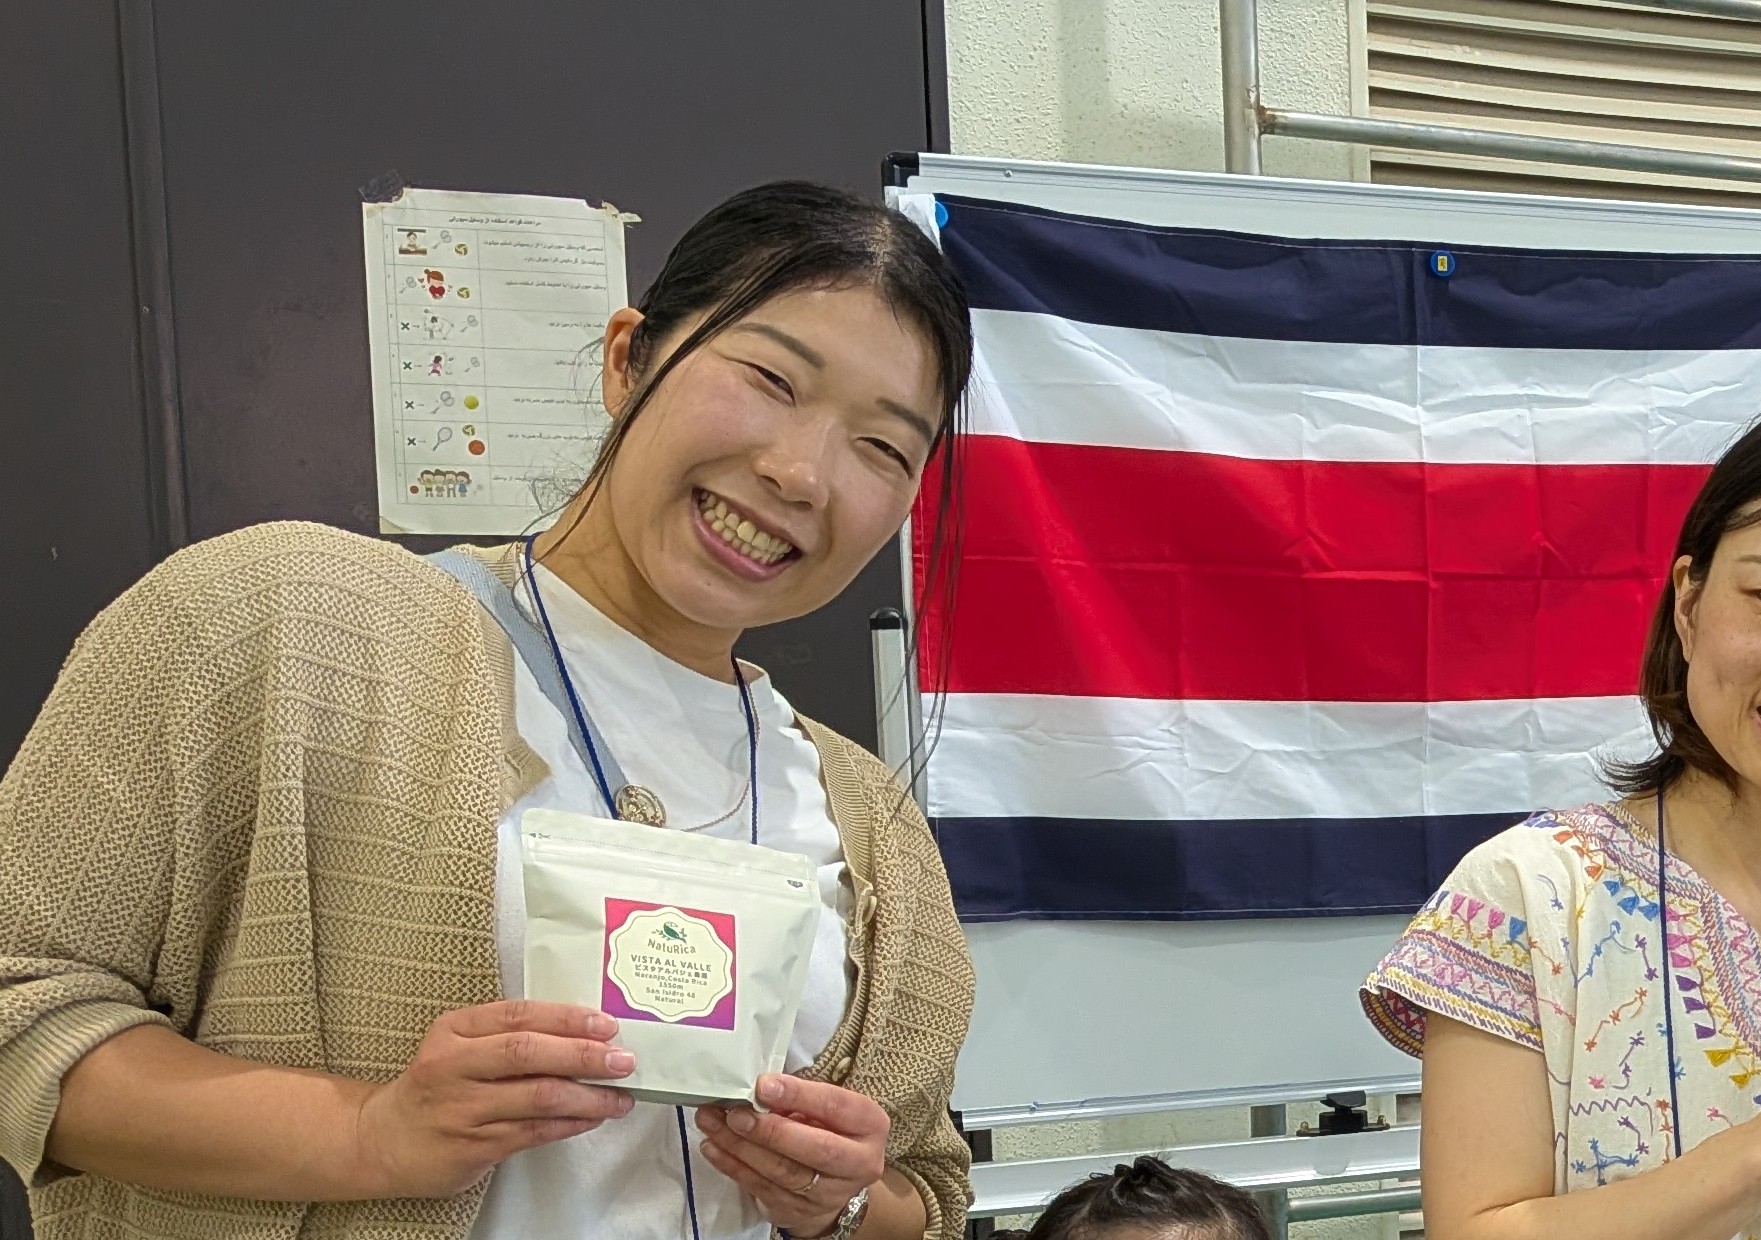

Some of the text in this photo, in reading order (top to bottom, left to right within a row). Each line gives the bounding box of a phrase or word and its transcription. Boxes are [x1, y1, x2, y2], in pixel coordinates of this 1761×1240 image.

[647, 938, 696, 954] NatuRica
[631, 954, 712, 973] VISTA AL VALLE
